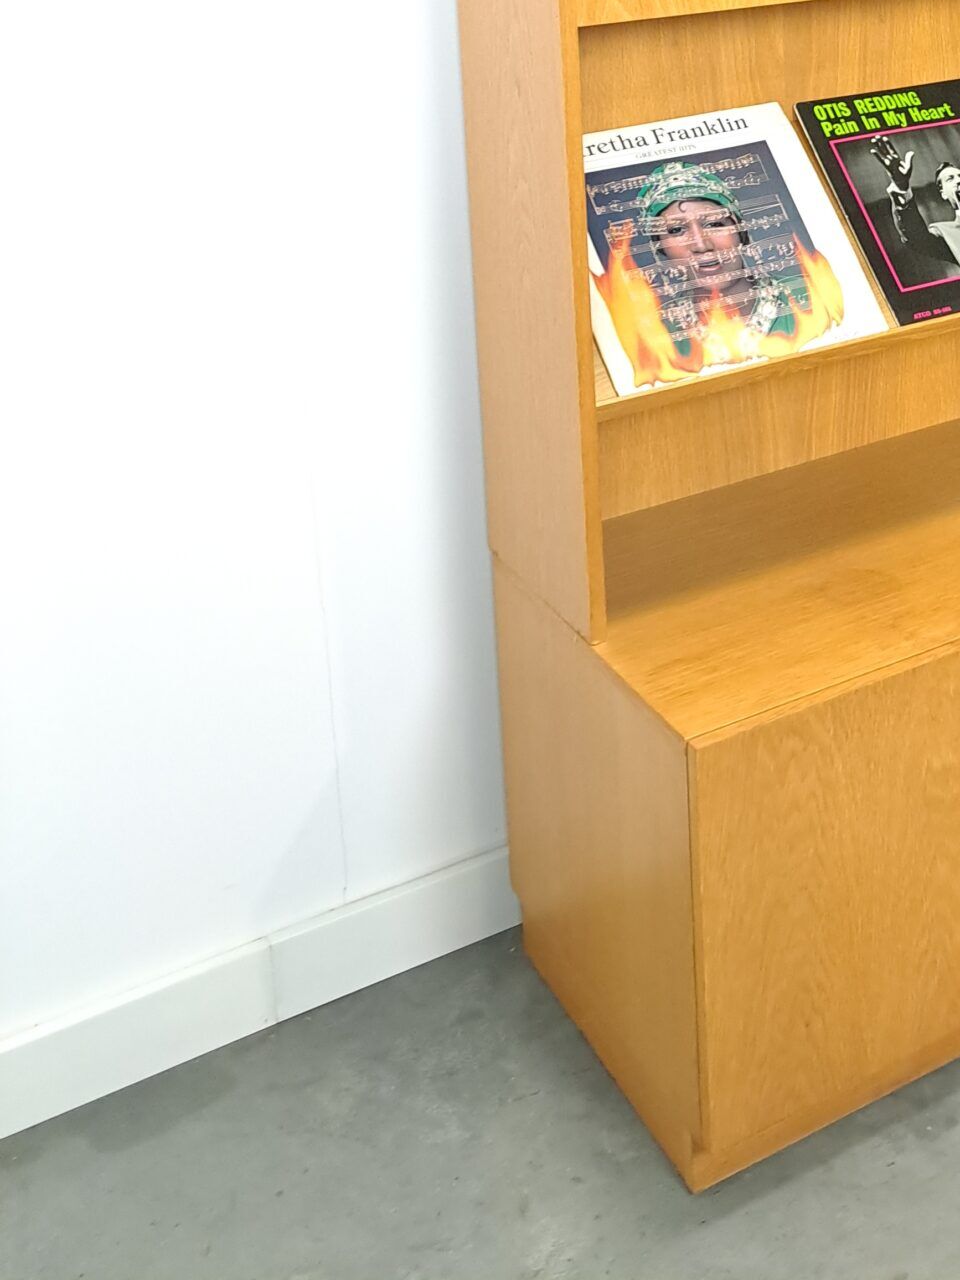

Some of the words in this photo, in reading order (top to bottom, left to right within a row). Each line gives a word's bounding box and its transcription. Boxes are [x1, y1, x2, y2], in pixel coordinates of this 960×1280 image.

[813, 101, 851, 121] OTIS
[853, 91, 922, 115] REDDING
[820, 118, 860, 138] Pain
[860, 115, 881, 131] In
[881, 110, 908, 128] My
[908, 103, 956, 123] Heart
[583, 133, 650, 157] retha
[650, 117, 749, 145] Franklin
